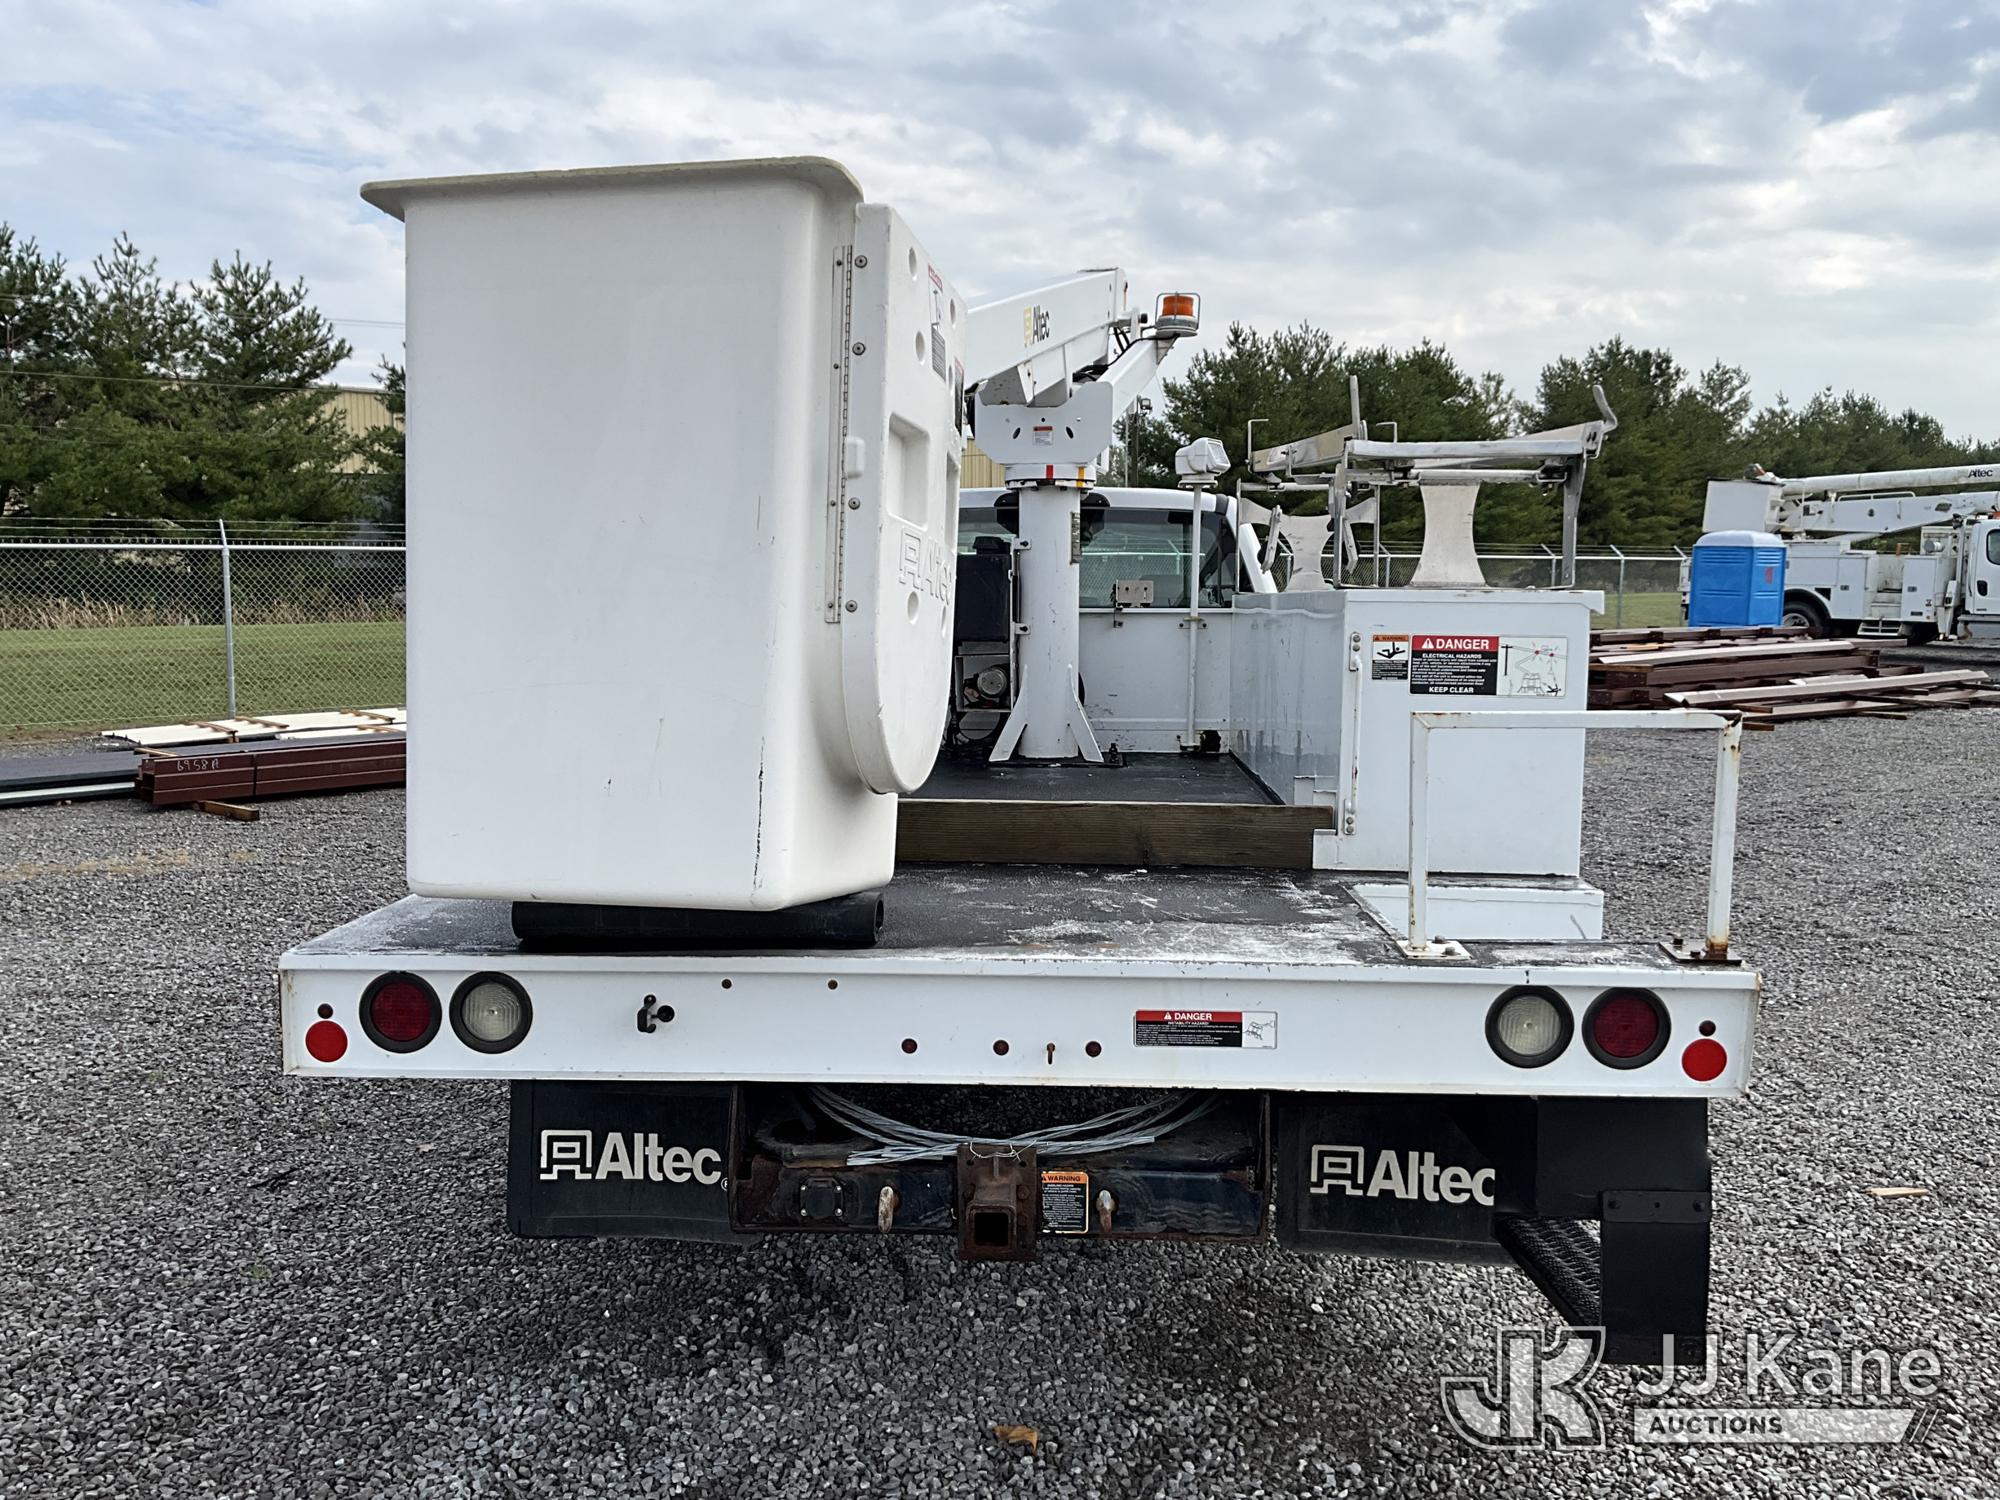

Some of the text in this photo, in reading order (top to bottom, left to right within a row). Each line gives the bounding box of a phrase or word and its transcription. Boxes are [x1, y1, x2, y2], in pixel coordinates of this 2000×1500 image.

[1032, 305, 1050, 344] Altec
[1968, 469, 1994, 478] Altec
[1436, 638, 1490, 650] DANGER
[1174, 1012, 1212, 1021] DANGER
[595, 1132, 722, 1185] Altec
[1366, 1149, 1496, 1206] Altec
